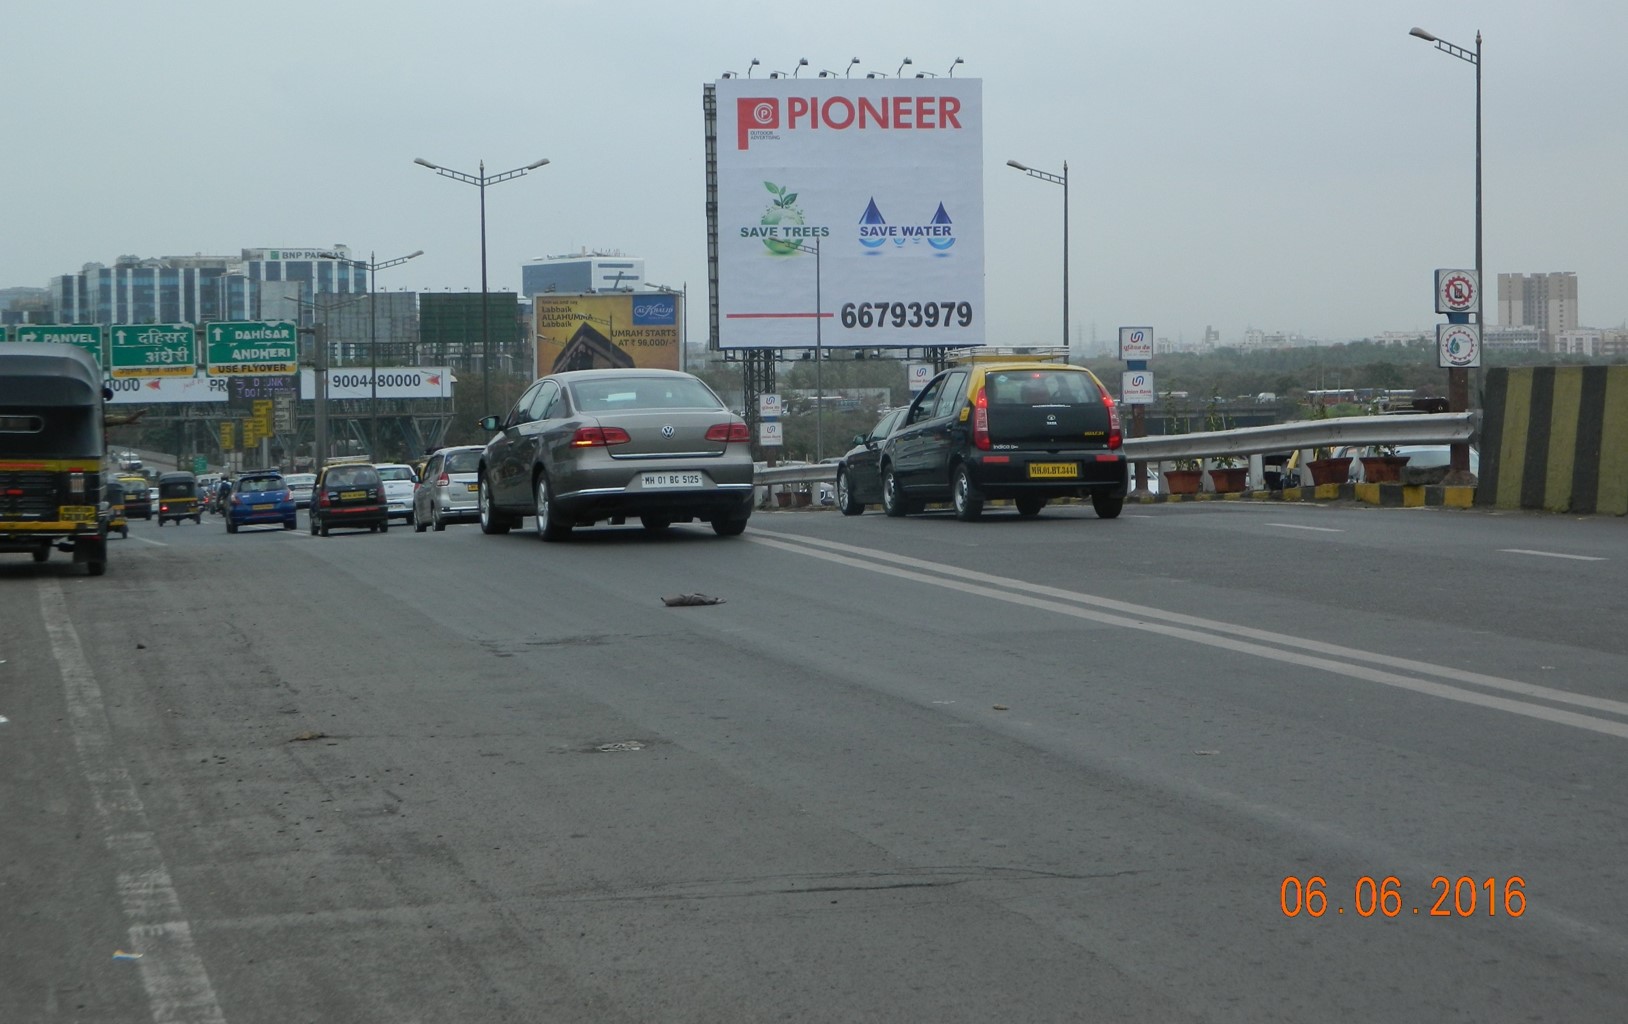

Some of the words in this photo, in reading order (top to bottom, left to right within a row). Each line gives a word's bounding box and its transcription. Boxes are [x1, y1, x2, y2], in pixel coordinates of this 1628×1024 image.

[787, 96, 962, 130] PIONEER
[740, 226, 777, 237] SAVE
[783, 226, 829, 237] TREES
[860, 226, 897, 237] SAVE
[902, 225, 952, 236] WATER
[282, 251, 302, 260] BNP
[841, 302, 973, 328] 66793979
[542, 320, 573, 328] Labbaik
[43, 333, 96, 343] PANVEL
[235, 328, 290, 340] DAHISAR
[612, 329, 643, 337] UMRAH
[645, 329, 677, 337] STARTS
[618, 339, 630, 347] AT
[232, 347, 291, 360] ANDHERI
[218, 364, 239, 374] USE
[241, 363, 287, 374] FLYOVER
[644, 476, 655, 485] MH
[658, 476, 666, 484] 01
[682, 475, 699, 484] 5125
